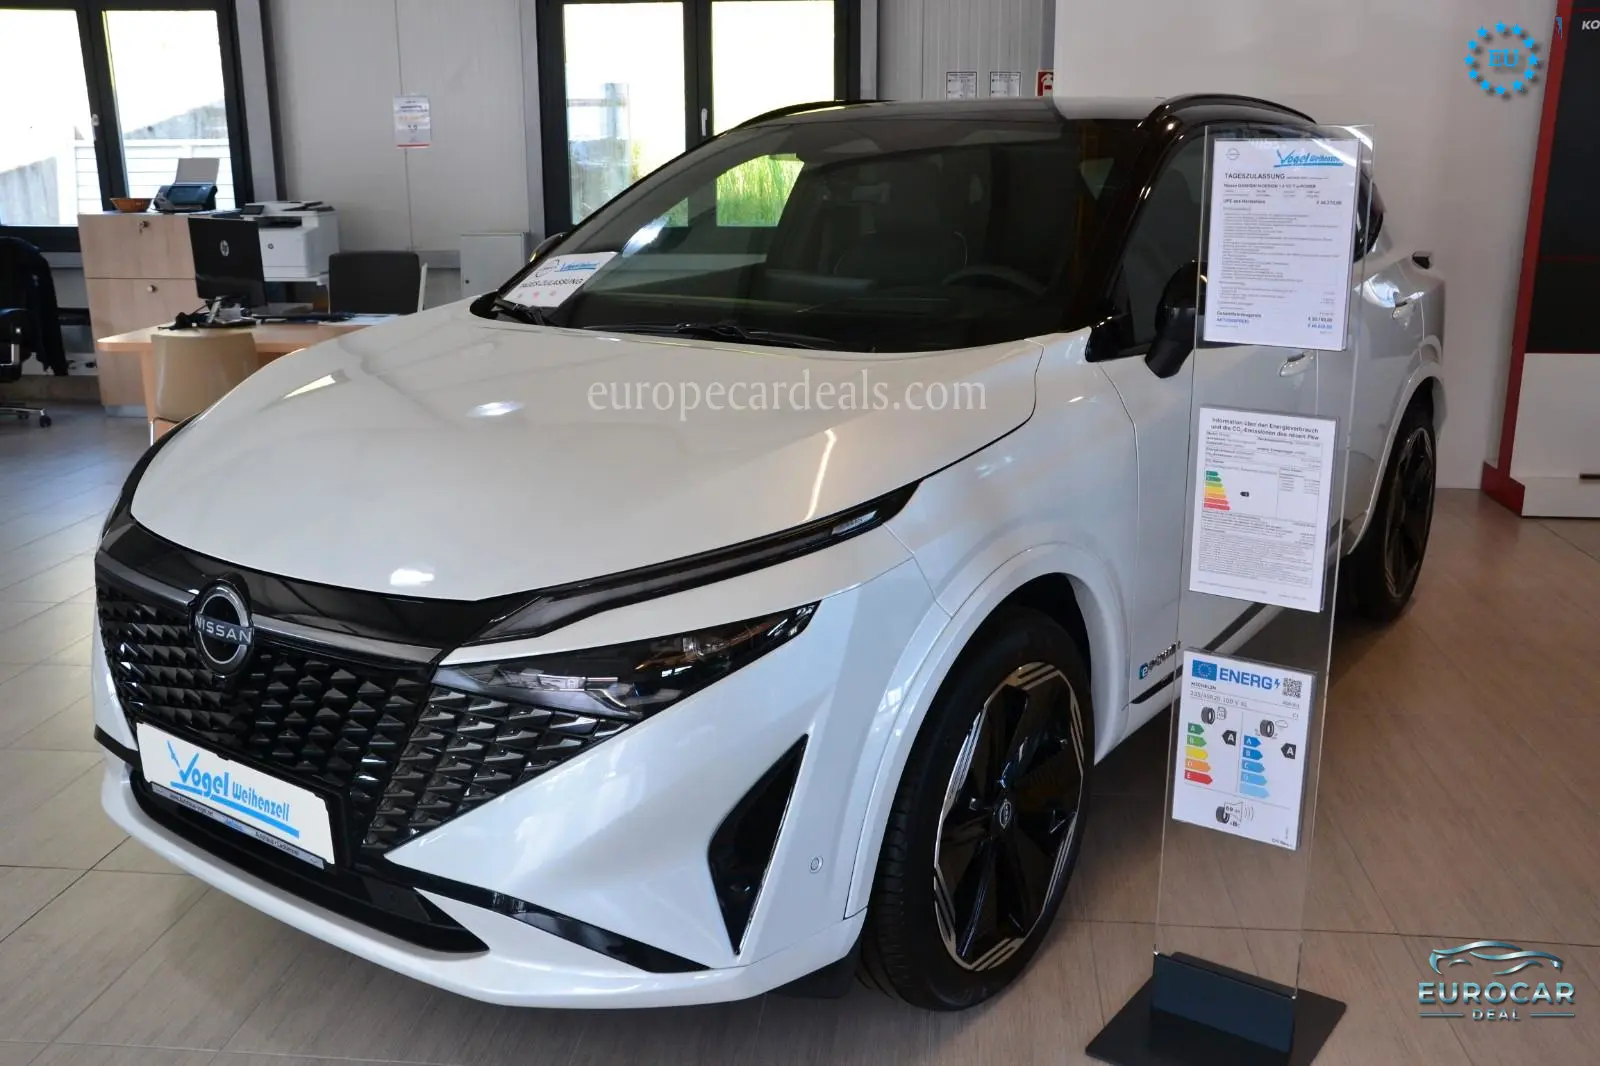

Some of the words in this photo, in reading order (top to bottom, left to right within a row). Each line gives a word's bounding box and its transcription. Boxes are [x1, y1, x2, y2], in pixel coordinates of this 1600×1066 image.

[1276, 149, 1310, 164] Vogel
[1269, 423, 1319, 433] Energieverbrauch
[195, 615, 251, 645] NISSAN
[1219, 667, 1273, 690] ENERG
[1190, 681, 1217, 691] MICHELIN
[1227, 733, 1235, 742] A
[1245, 737, 1252, 745] A
[1286, 747, 1294, 756] A
[167, 740, 230, 797] Vogel
[232, 781, 291, 822] Weihenzell
